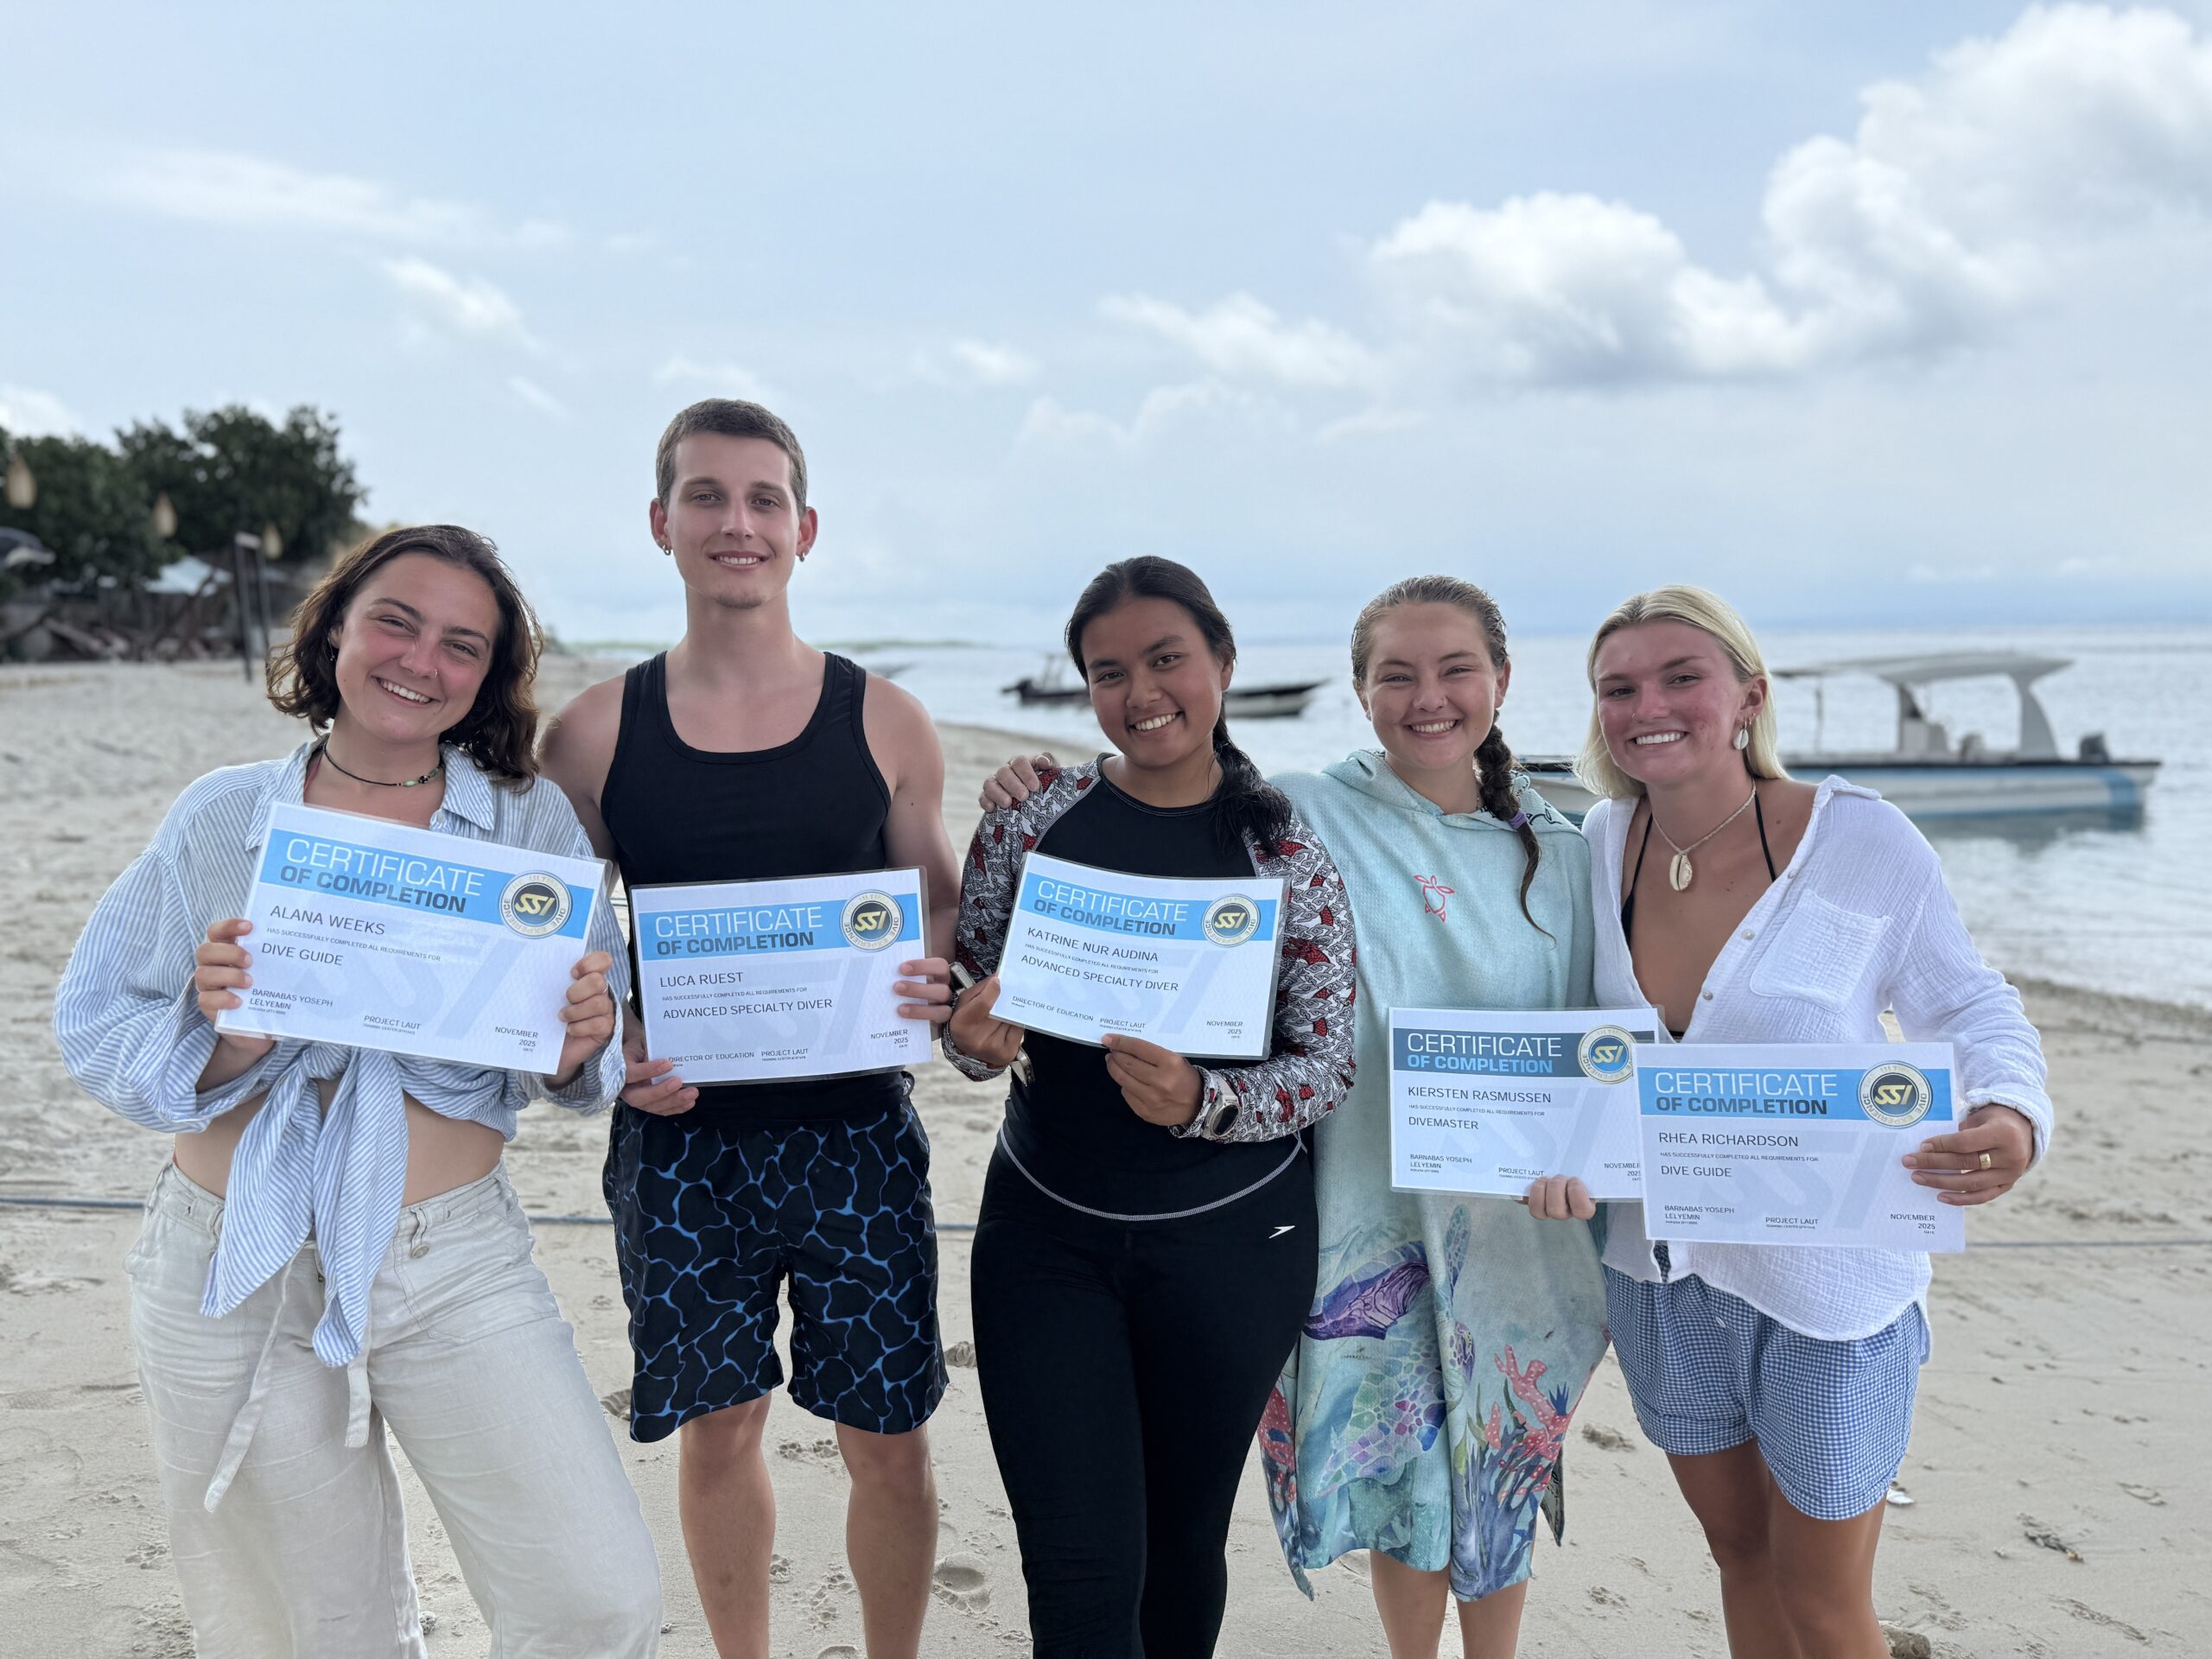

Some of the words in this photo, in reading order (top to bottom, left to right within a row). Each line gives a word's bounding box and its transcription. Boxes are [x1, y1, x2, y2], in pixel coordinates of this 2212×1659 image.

[286, 838, 485, 896] CERTIFICATE
[280, 865, 313, 884] OF
[316, 872, 467, 913] COMPLETION
[514, 893, 556, 916] SSI
[1038, 880, 1189, 922] CERTIFICATE
[270, 905, 323, 925] ALANA
[329, 914, 385, 935] WEEKS
[656, 906, 823, 938] CERTIFICATE
[854, 911, 887, 931] SSI
[1033, 899, 1058, 914] OF
[1060, 906, 1176, 936] COMPLETION
[1214, 912, 1247, 929] SSI
[657, 939, 683, 956] OF
[687, 931, 814, 954] COMPLETION
[1027, 926, 1079, 950] KATRINE
[1082, 942, 1109, 956] NUR
[1111, 948, 1159, 962] AUDINA
[261, 942, 296, 958] DIVE
[299, 949, 344, 966] GUIDE
[660, 975, 696, 988] LUCA
[699, 972, 743, 985] RUEST
[1020, 954, 1080, 977] ADVANCED
[1083, 971, 1143, 988] SPECIALTY
[1145, 980, 1179, 991] DIVER
[250, 997, 291, 1010] LELYEMIN
[251, 988, 297, 1001] BARNABAS
[299, 995, 334, 1007] YOSEPH
[663, 1006, 728, 1020] ADVANCED
[730, 1001, 793, 1015] SPECIALTY
[797, 999, 833, 1010] DIVER
[1012, 995, 1046, 1009] DIRECTOR
[1056, 1007, 1094, 1021] EDUCATION
[364, 1014, 400, 1027] PROJECT
[401, 1020, 422, 1030] LAUT
[1099, 1018, 1128, 1027] PROJECT
[494, 1026, 538, 1039] NOVEMBER
[870, 1028, 908, 1039] NOVEMBER
[893, 1036, 909, 1045] 2025
[518, 1039, 537, 1047] 2025
[1408, 1033, 1562, 1057] CERTIFICATE
[668, 1054, 703, 1063] DIRECTOR
[715, 1052, 754, 1060] EDUCATION
[1408, 1054, 1430, 1068] OF
[1434, 1055, 1552, 1073] COMPLETION
[1592, 1045, 1624, 1064] SSI
[1655, 1071, 1838, 1096] CERTIFICATE
[1408, 1086, 1469, 1100] KIERSTEN
[1472, 1090, 1551, 1103] RASMUSSEN
[1874, 1084, 1913, 1105] SSI
[1656, 1096, 1682, 1111] OF
[1688, 1097, 1827, 1115] COMPLETION
[1408, 1116, 1478, 1130] DIVEMASTER
[1658, 1132, 1698, 1144] RHEA
[1701, 1134, 1798, 1147] RICHARDSON
[1409, 1154, 1445, 1162] BARNABAS
[1498, 1166, 1527, 1175] PROJECT
[1661, 1165, 1690, 1176] DIVE
[1693, 1166, 1732, 1178] GUIDE
